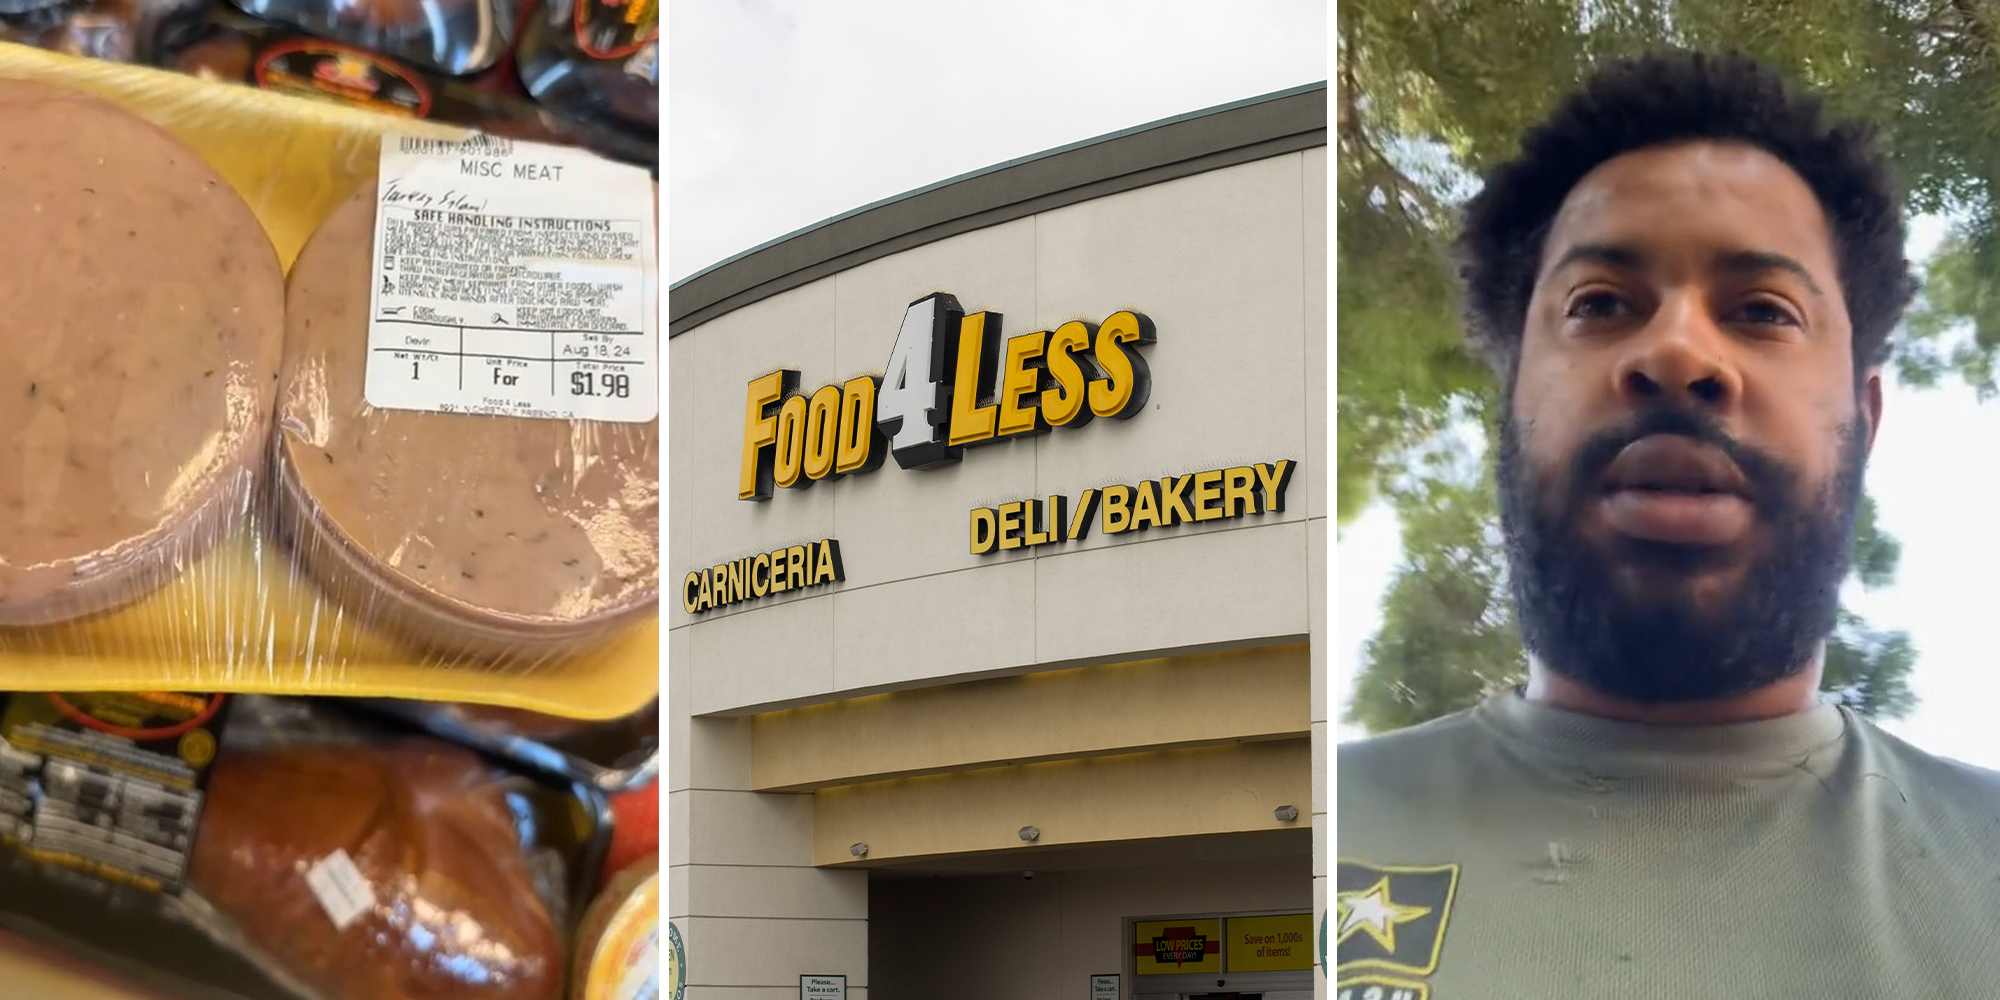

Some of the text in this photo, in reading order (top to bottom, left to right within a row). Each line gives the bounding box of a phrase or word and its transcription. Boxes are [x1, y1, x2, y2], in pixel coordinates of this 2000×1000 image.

[460, 159, 563, 181] MISC MEAT
[414, 209, 611, 232] SAFE HANDLING INSTRUCTIONS
[401, 257, 421, 266] KEEP
[394, 352, 409, 360] Net
[562, 345, 590, 358] Aug
[614, 346, 631, 357] 24
[507, 359, 528, 368] Price
[576, 362, 625, 372] Total Price
[411, 361, 420, 380] 1
[494, 367, 520, 386] For
[571, 371, 630, 399] $1.98
[876, 293, 964, 470] 4
[483, 397, 504, 406] Food
[682, 538, 845, 615] CARNICERIA
[1244, 932, 1303, 945] Save on 1,000s
[1156, 939, 1204, 952] LOW PRICES
[1257, 946, 1291, 958] of items!
[1162, 952, 1197, 960] EVERY DAY!
